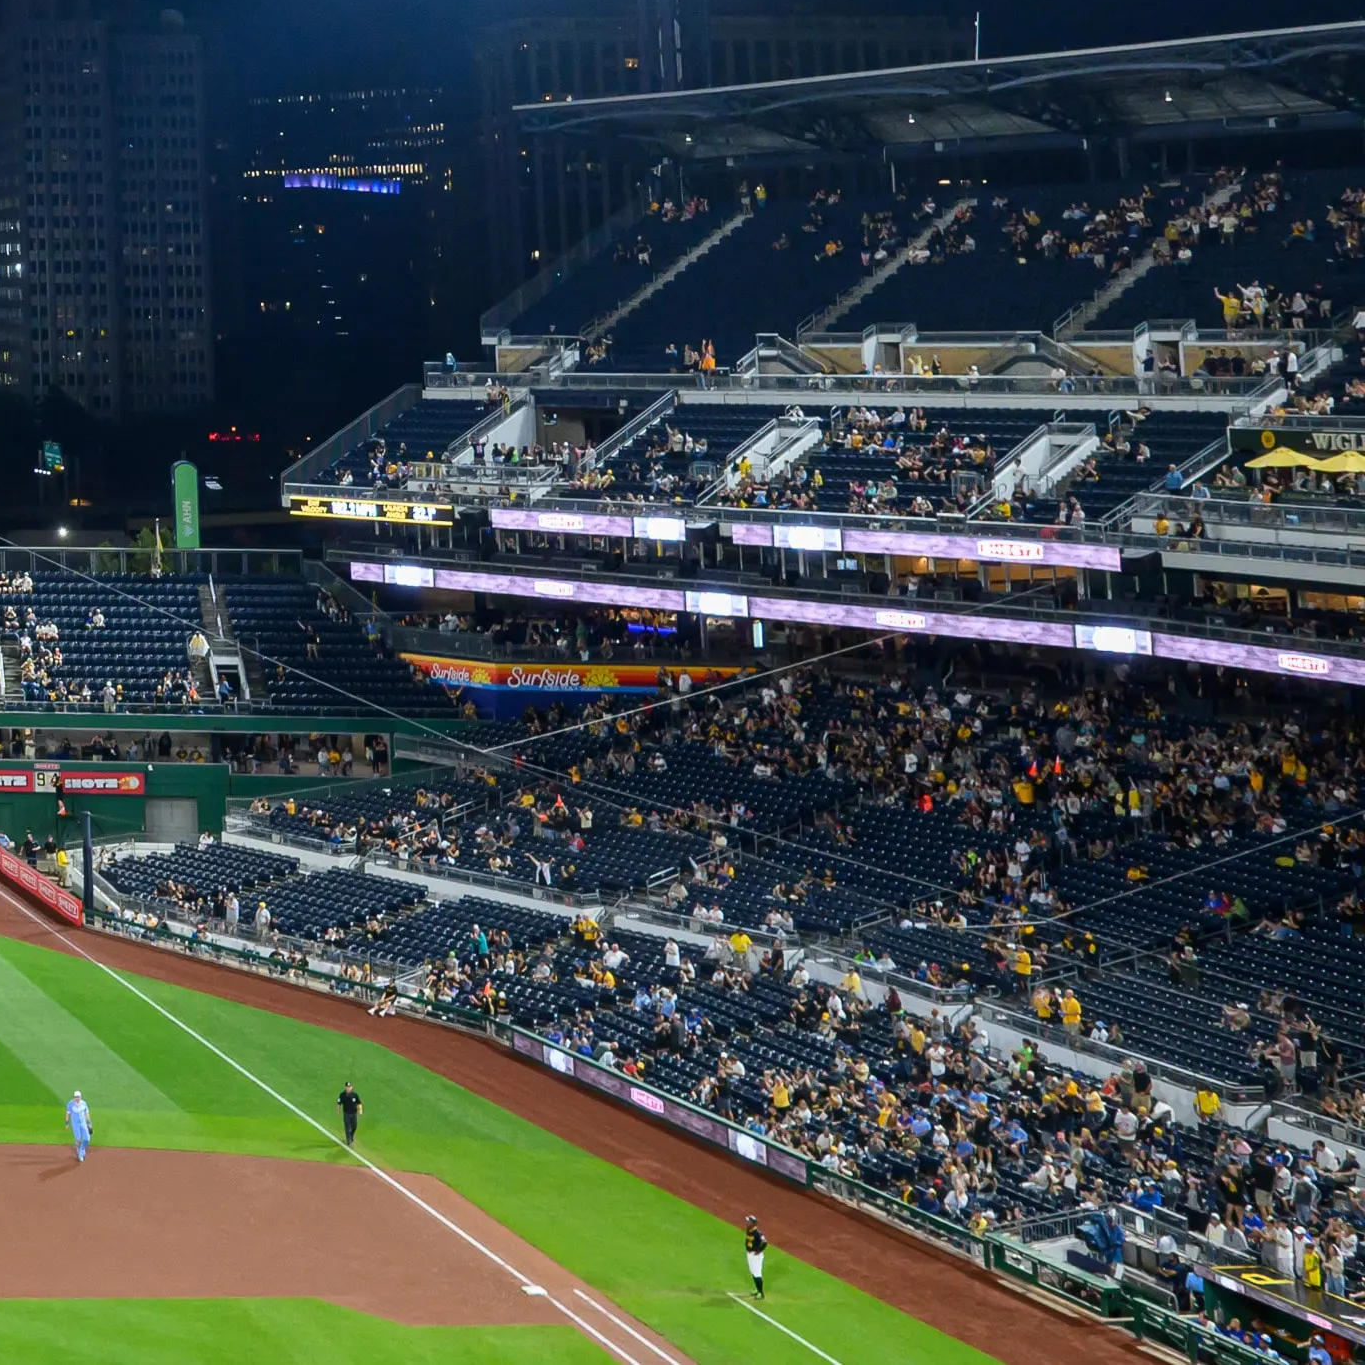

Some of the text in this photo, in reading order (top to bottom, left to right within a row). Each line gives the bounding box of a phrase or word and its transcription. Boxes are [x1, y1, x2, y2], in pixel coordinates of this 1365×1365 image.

[182, 500, 191, 523] AHN
[431, 663, 469, 682] Surfside
[507, 666, 579, 688] Surfside
[64, 778, 118, 788] SHOTZ
